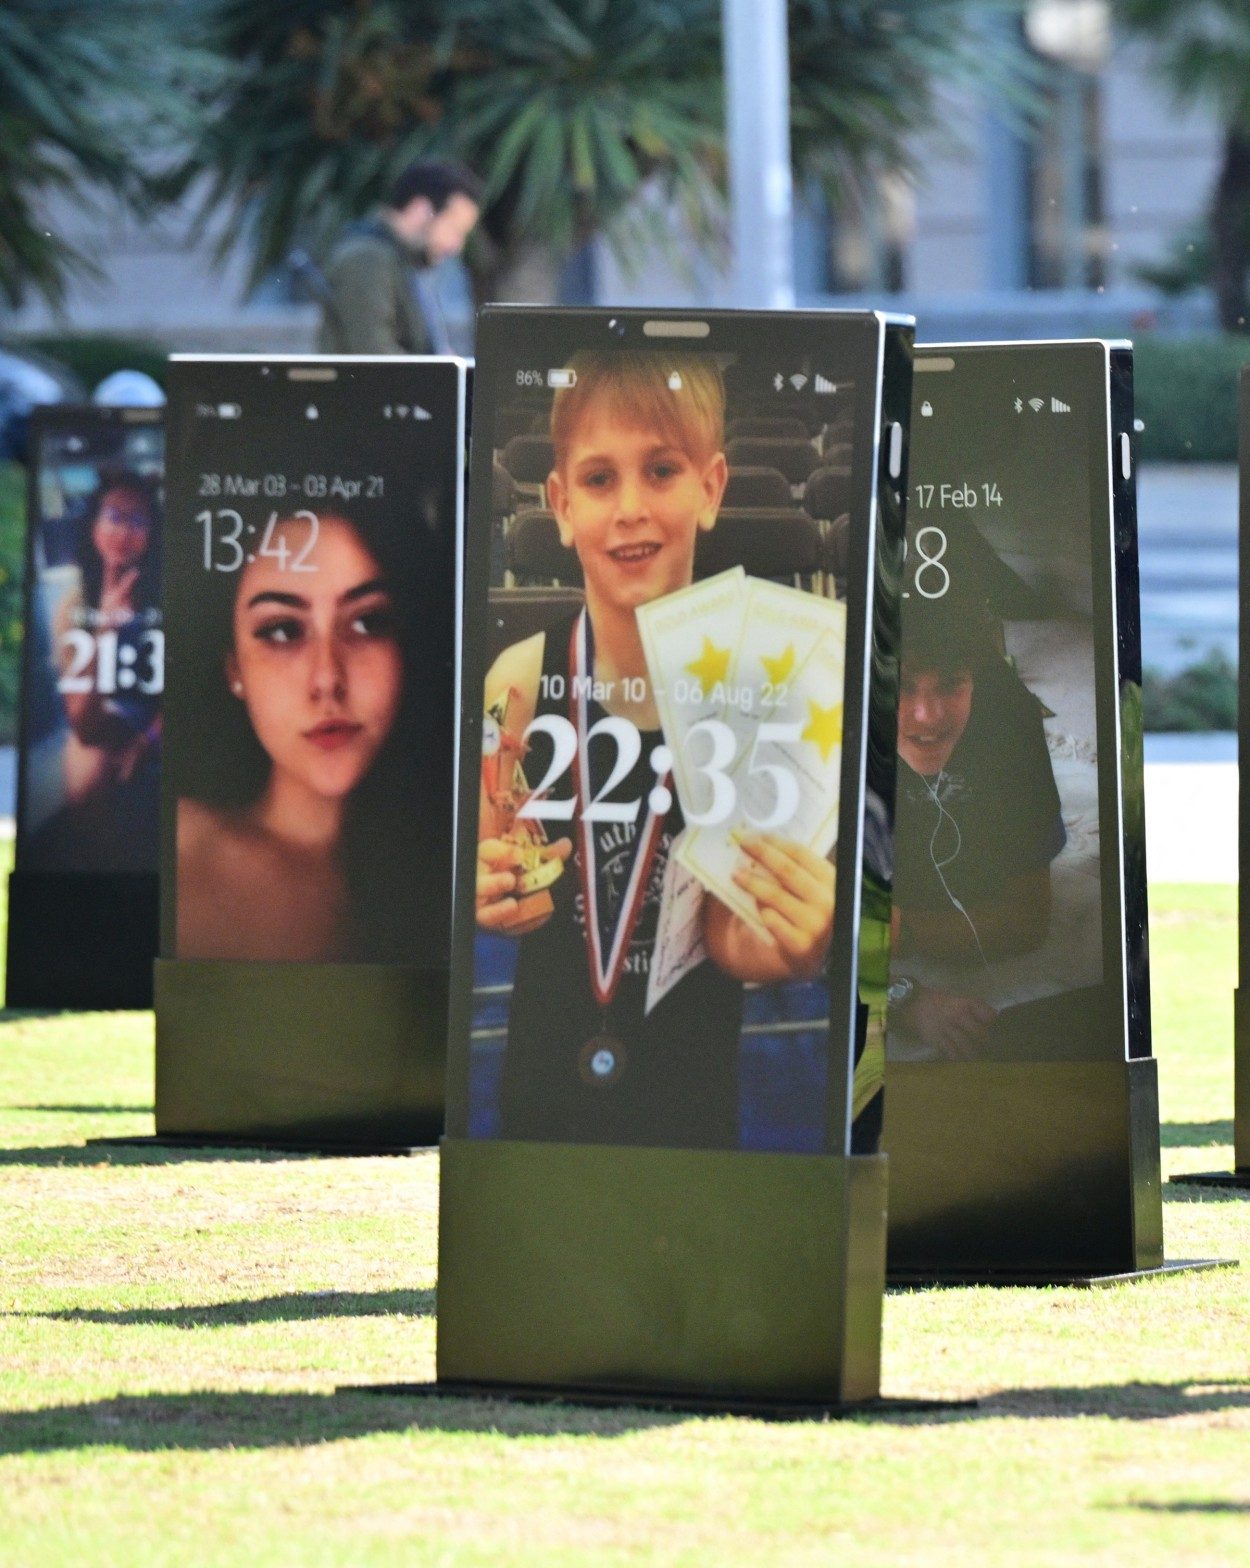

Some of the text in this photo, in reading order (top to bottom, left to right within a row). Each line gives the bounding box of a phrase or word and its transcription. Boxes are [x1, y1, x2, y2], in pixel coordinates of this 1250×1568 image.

[516, 370, 543, 386] 86%
[199, 474, 221, 496] 28
[223, 474, 260, 496] Mar
[264, 474, 287, 497] 03
[304, 474, 327, 497] 03
[330, 475, 362, 500] Apr
[366, 475, 384, 497] 21
[915, 482, 1003, 509] 17 Feb 14
[195, 508, 320, 572] 13:42
[540, 675, 565, 700] 10
[572, 676, 615, 700] Mar
[621, 677, 646, 702] 10
[673, 679, 703, 702] 06
[709, 681, 751, 709] Aug
[760, 683, 788, 707] 22
[516, 713, 804, 828] 22:35
